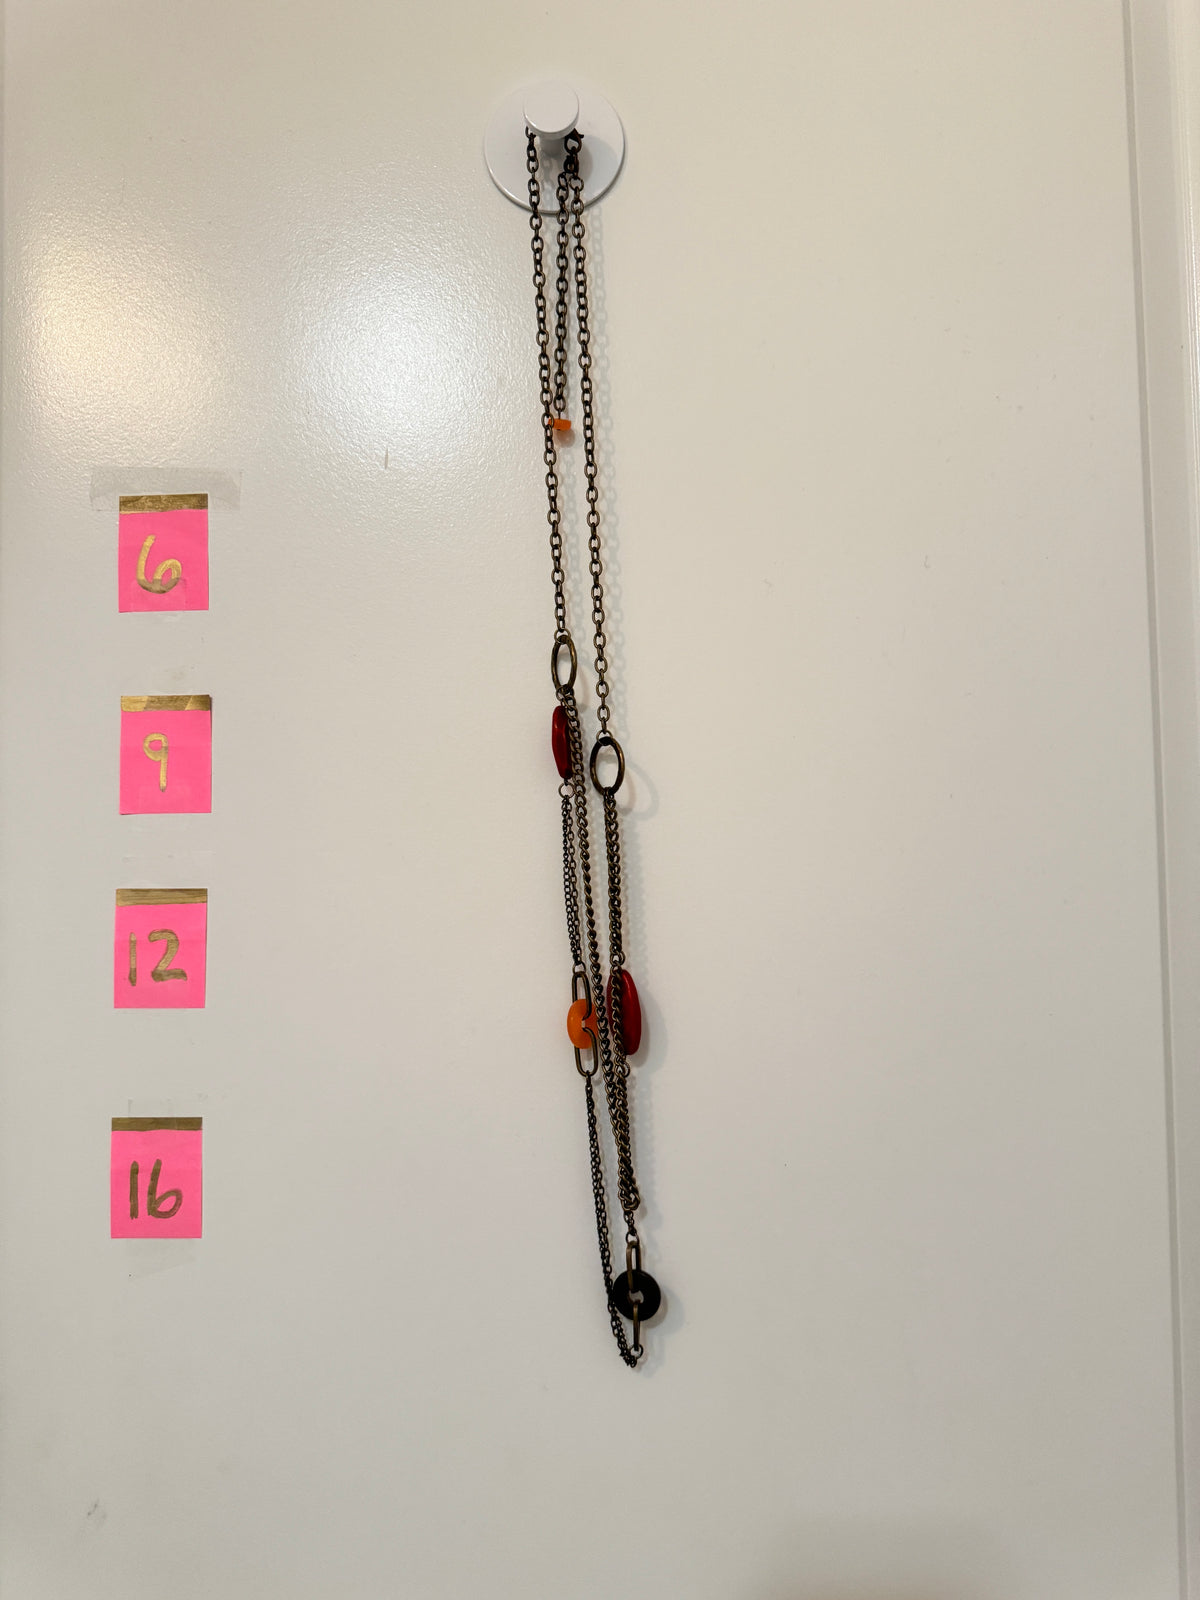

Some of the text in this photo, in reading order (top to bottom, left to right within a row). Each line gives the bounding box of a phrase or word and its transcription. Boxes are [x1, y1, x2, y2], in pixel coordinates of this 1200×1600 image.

[136, 534, 182, 594] 6
[143, 732, 169, 792] 9
[128, 929, 187, 986] 12
[129, 1159, 183, 1220] 16
